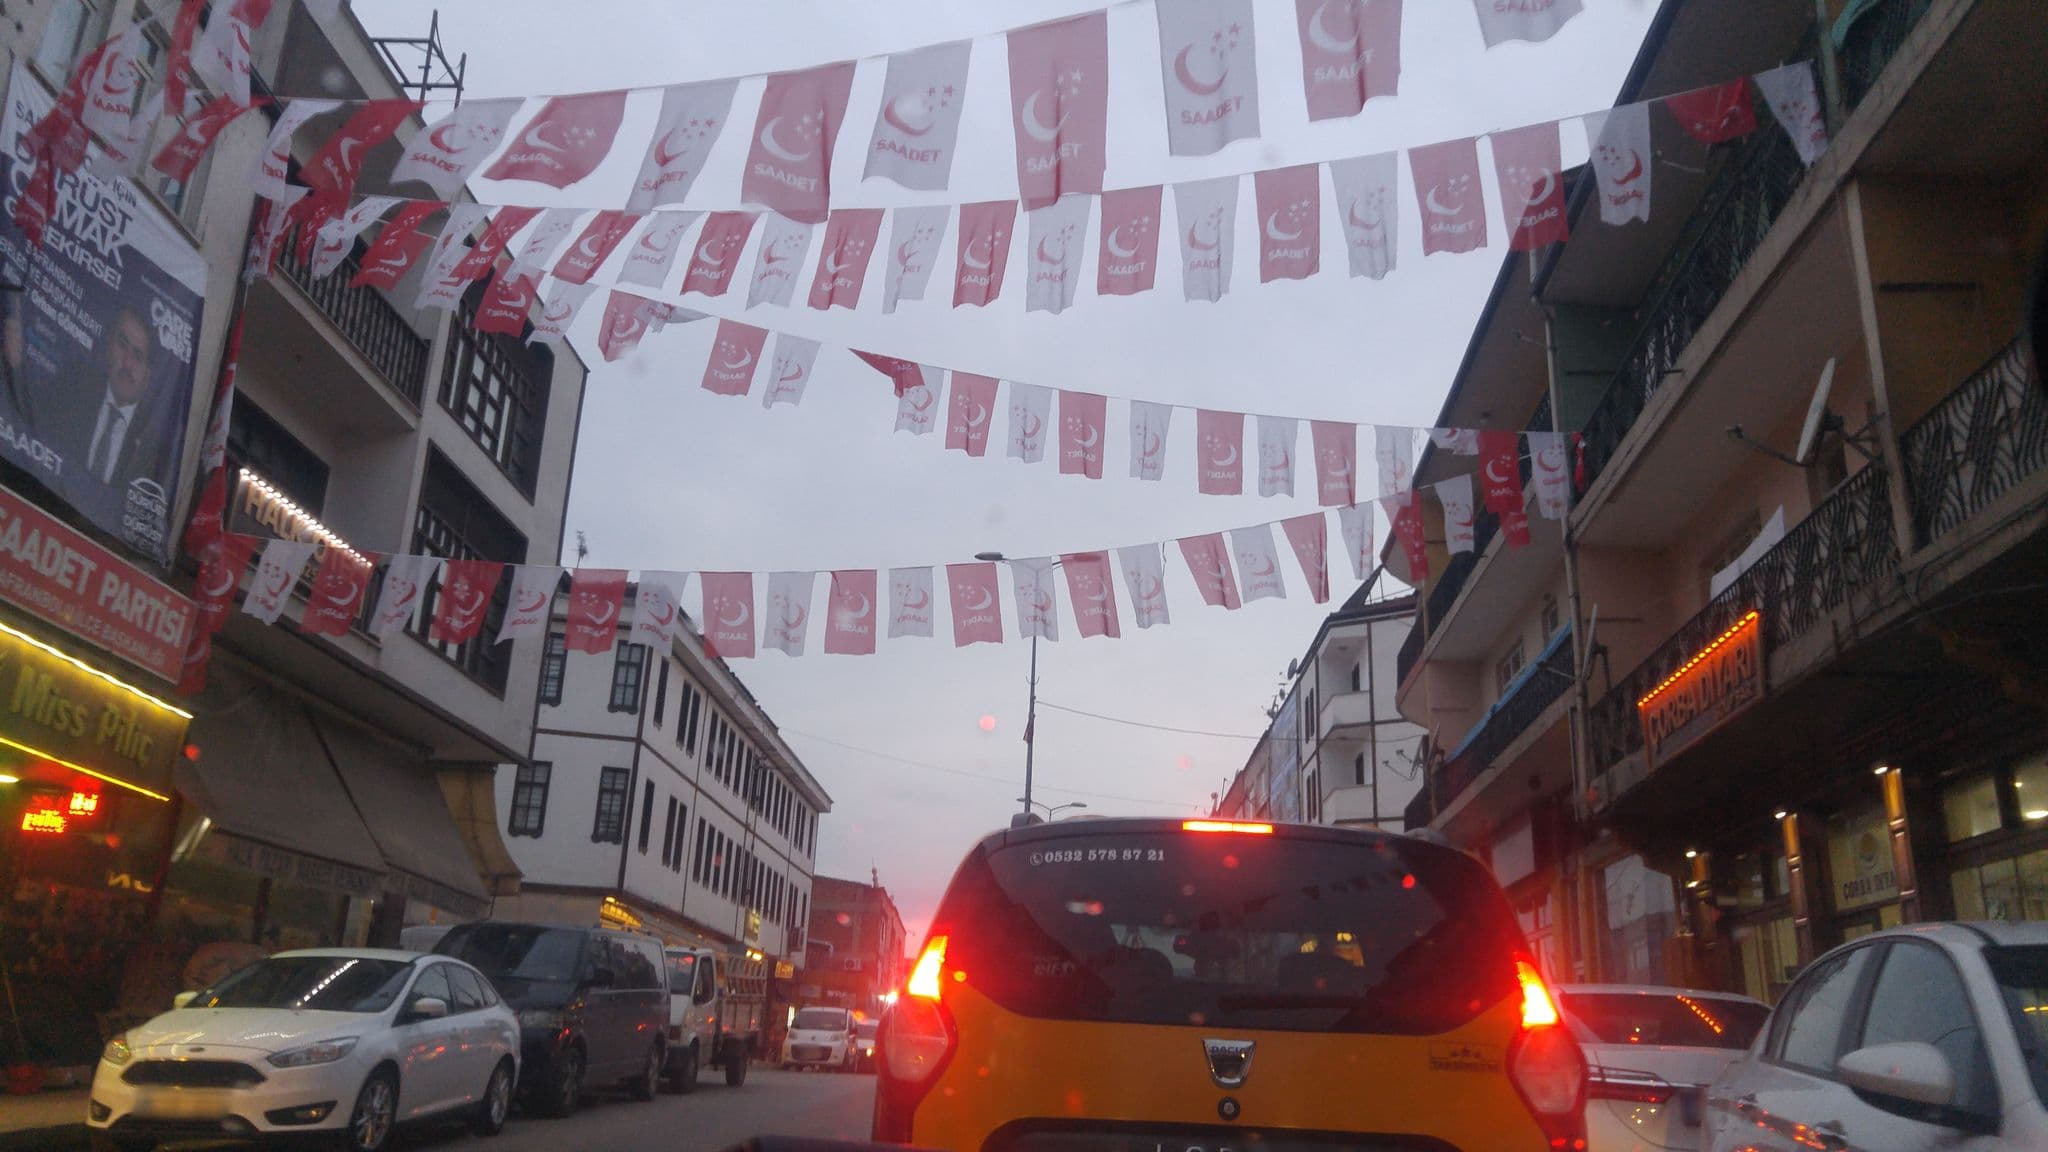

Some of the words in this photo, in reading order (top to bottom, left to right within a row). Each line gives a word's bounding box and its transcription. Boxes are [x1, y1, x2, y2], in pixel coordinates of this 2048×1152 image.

[1181, 95, 1243, 126] SAADET
[876, 138, 942, 164] SAADET
[754, 161, 817, 193] SAADET
[1106, 260, 1147, 276] SAADET
[98, 570, 188, 648] PARTİSİ
[10, 665, 86, 737] Miss
[1044, 850, 1083, 863] 0532
[1088, 849, 1117, 862] 578
[1122, 849, 1140, 862] 87
[1147, 848, 1165, 862] 21
